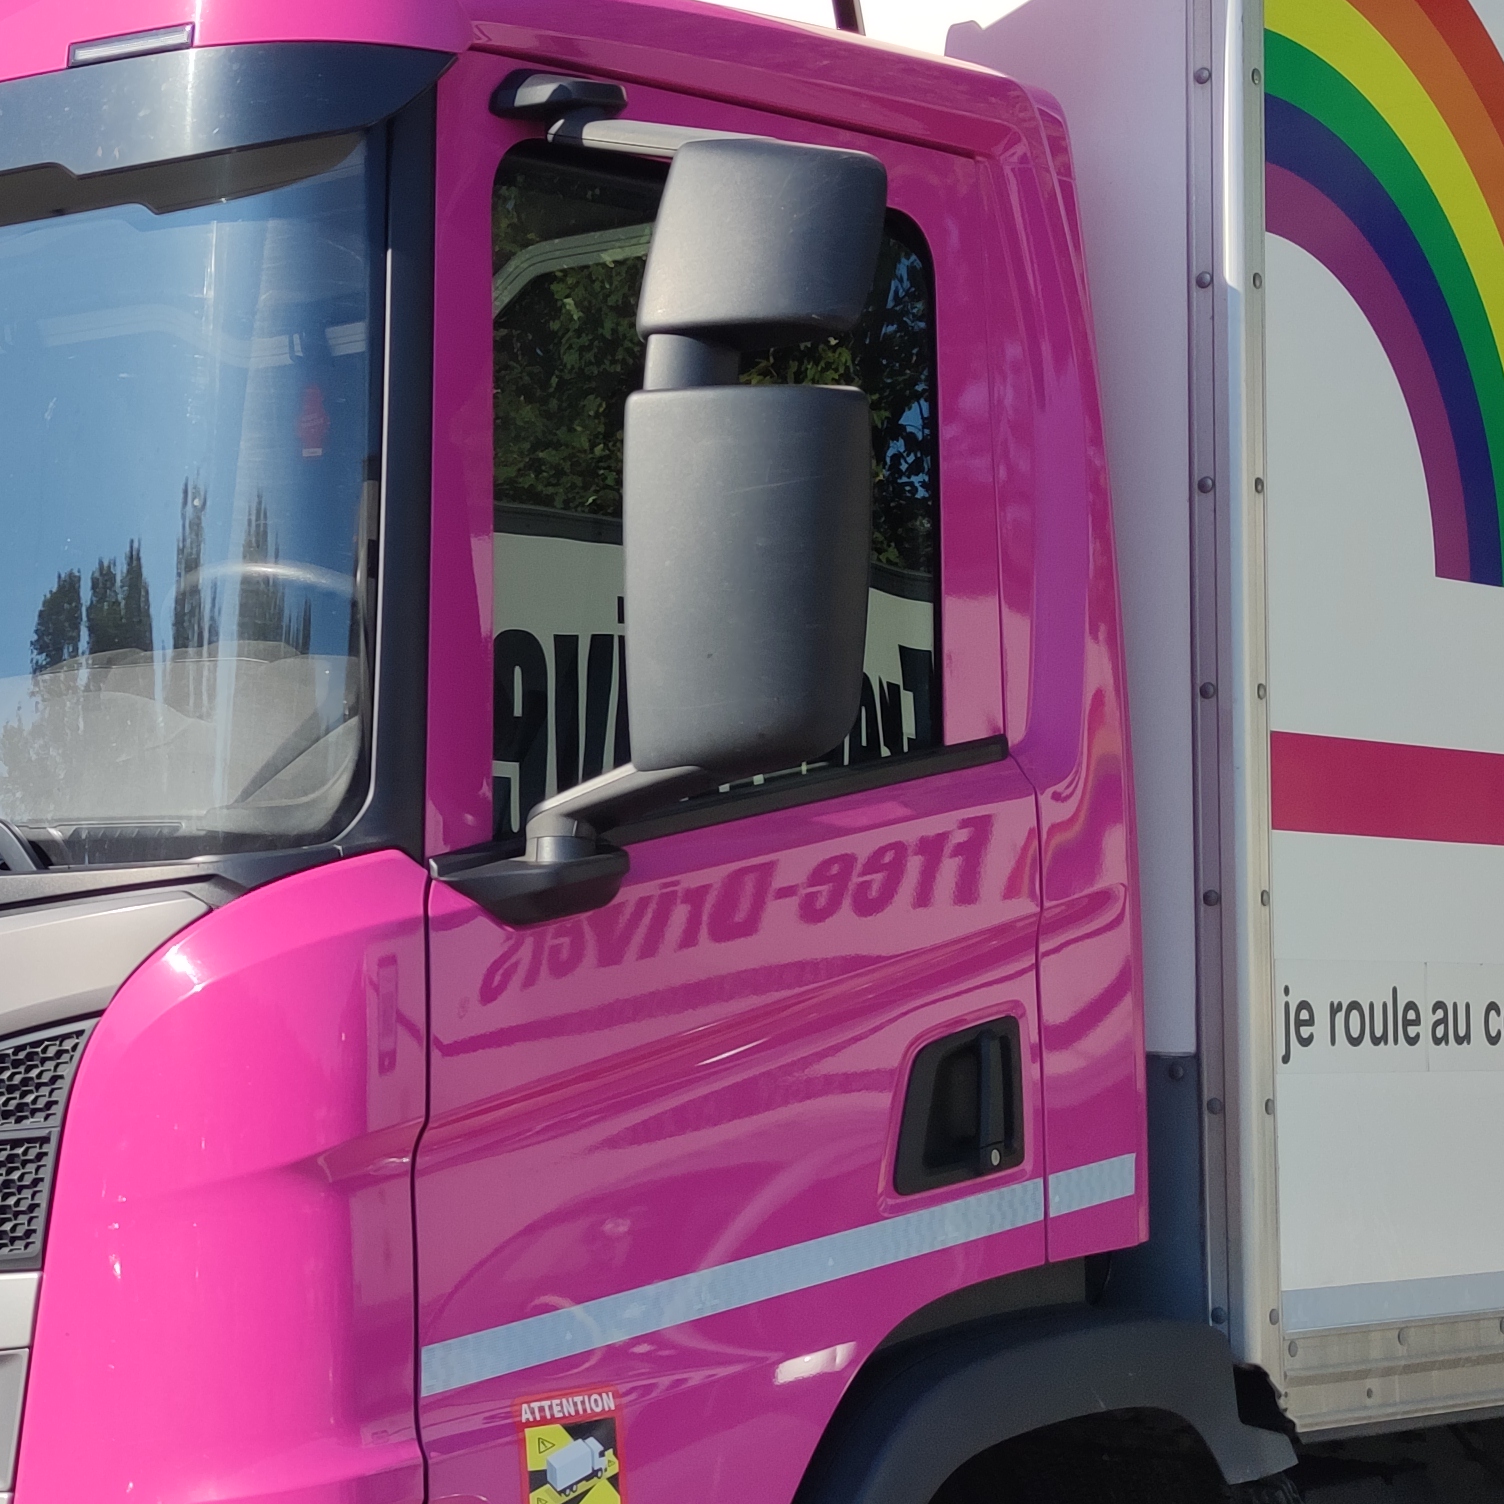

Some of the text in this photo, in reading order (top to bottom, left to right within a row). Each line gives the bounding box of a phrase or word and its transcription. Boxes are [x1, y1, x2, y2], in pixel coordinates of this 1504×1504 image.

[1281, 984, 1316, 1065] je
[1329, 985, 1422, 1047] roule
[1431, 1000, 1472, 1047] au
[521, 1392, 616, 1423] ATTENTION
